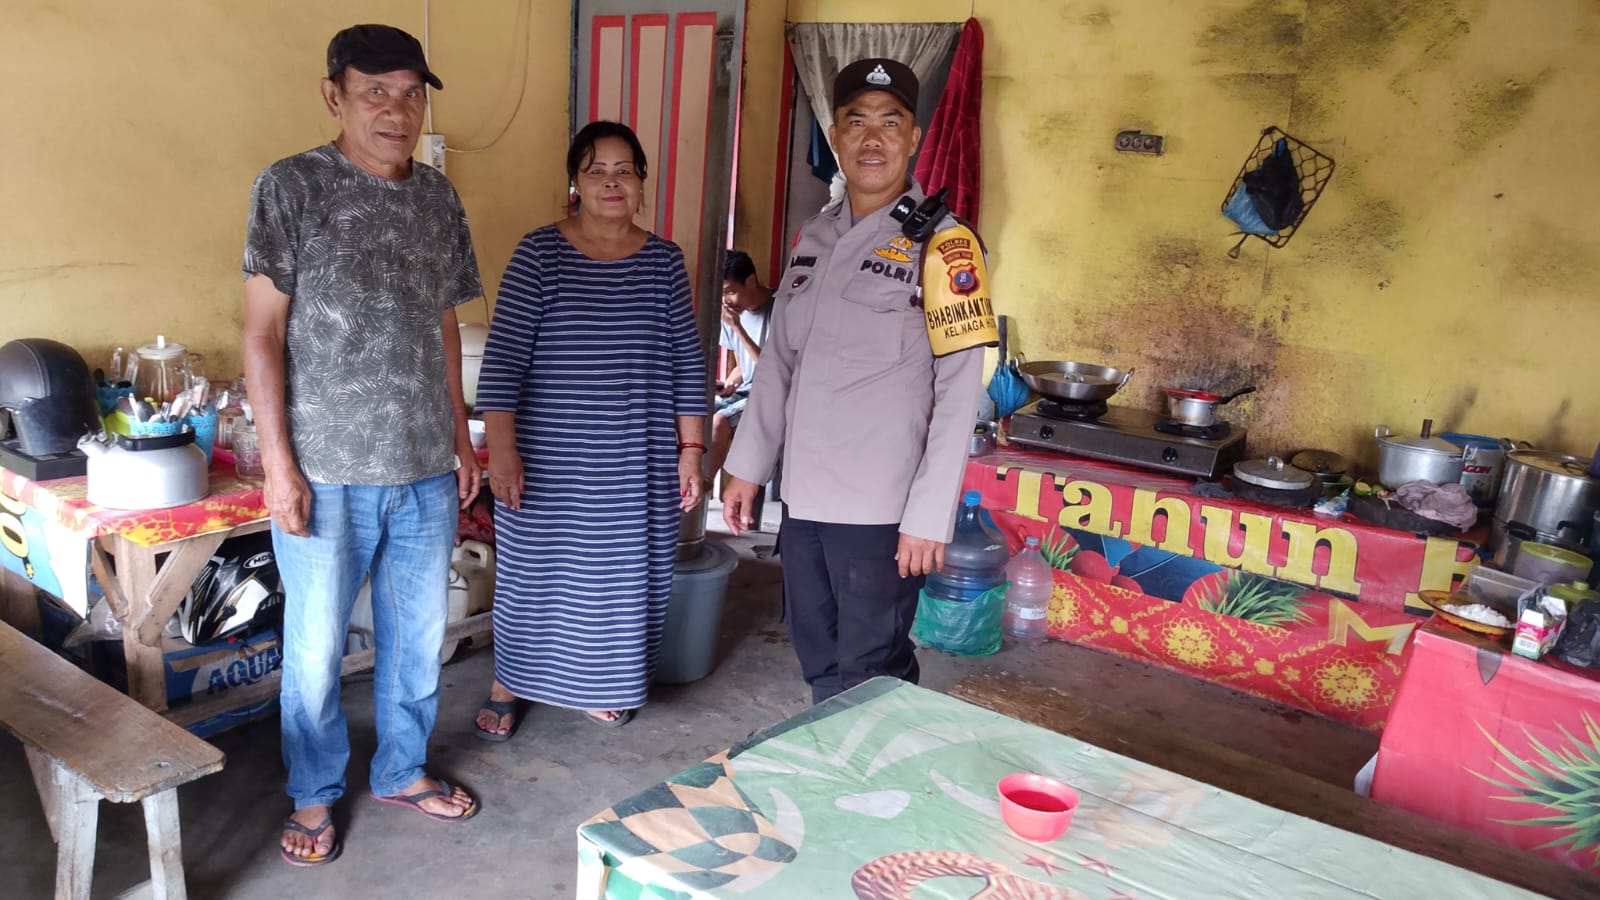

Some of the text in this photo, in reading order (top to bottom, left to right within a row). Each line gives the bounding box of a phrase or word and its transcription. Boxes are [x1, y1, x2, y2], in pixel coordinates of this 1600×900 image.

[860, 259, 914, 284] POLRI
[996, 463, 1362, 598] Tahun
[206, 648, 282, 695] AQUA
